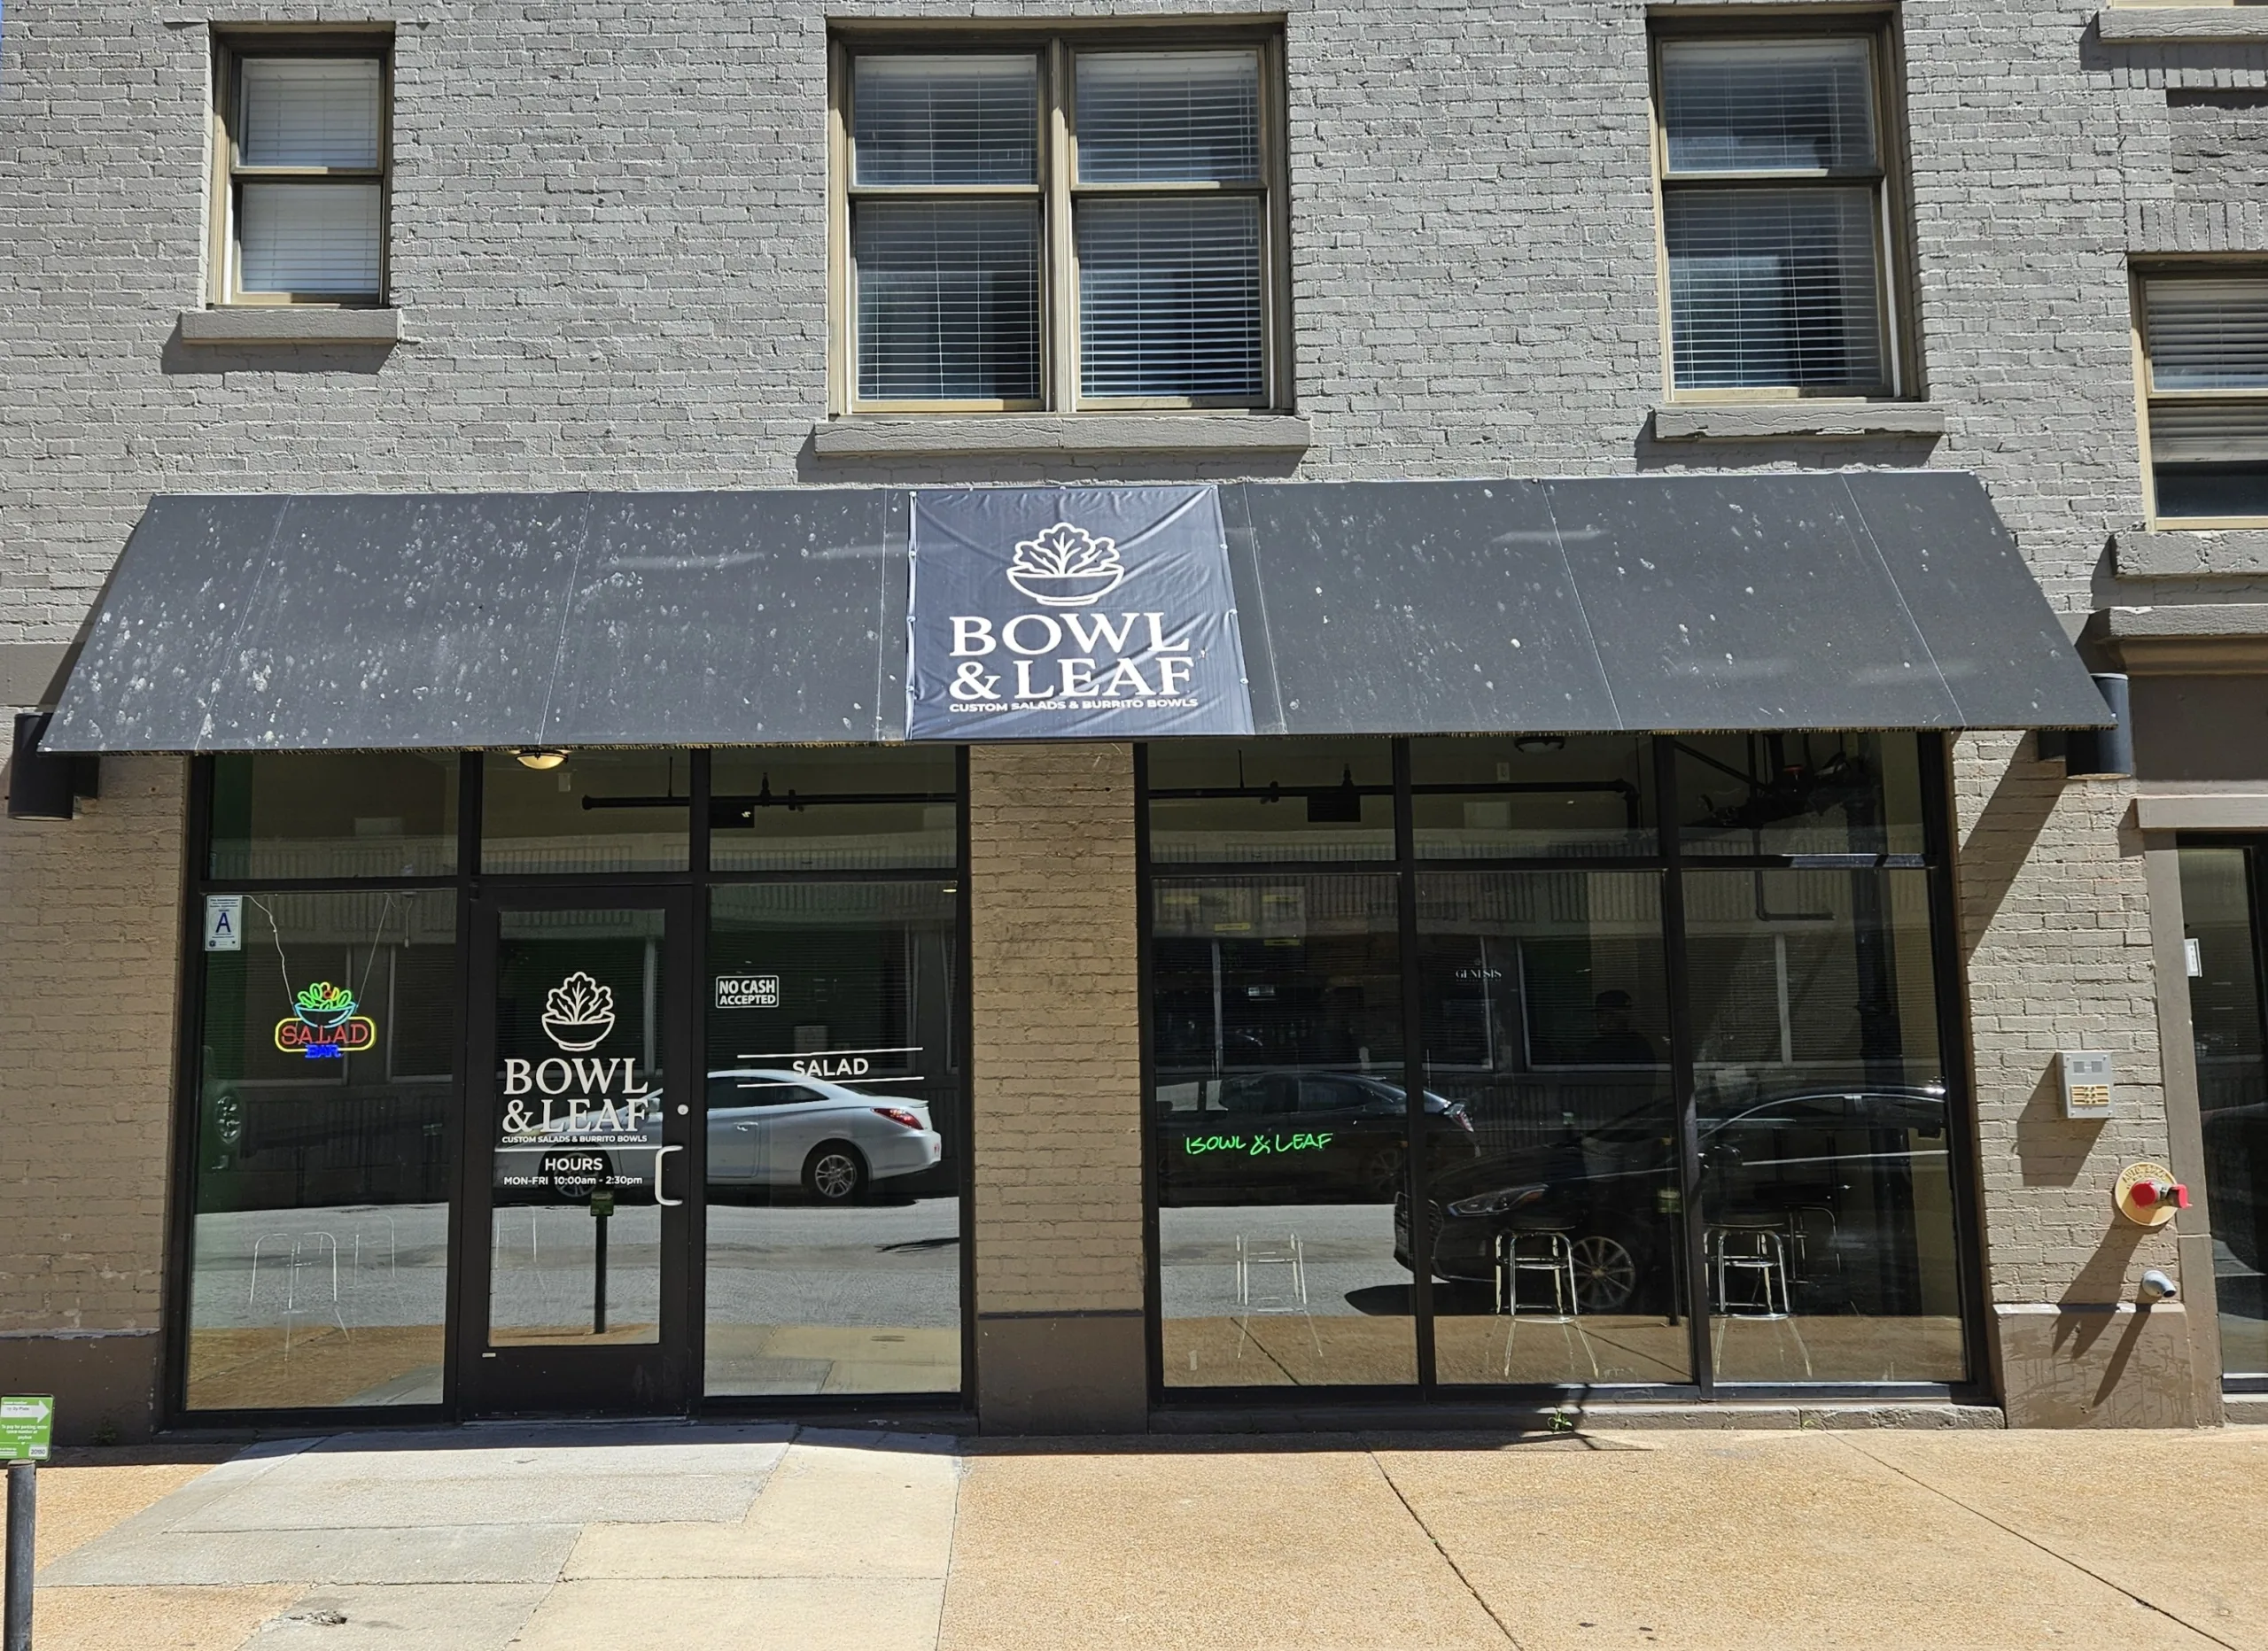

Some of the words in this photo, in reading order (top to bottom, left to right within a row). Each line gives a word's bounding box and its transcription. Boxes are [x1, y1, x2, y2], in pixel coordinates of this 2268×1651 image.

[949, 612, 1189, 656] BOWL
[949, 661, 1001, 701] &
[1014, 656, 1194, 699] LEAF
[949, 702, 1008, 713] CUSTOM
[1011, 701, 1067, 711] SALADS
[1068, 701, 1079, 710] &
[1082, 700, 1144, 709] BURRITO
[1147, 698, 1199, 709] BOWLS
[215, 912, 231, 933] A
[719, 981, 739, 994] NO
[741, 980, 775, 994] CASH
[719, 994, 776, 1005] ACCEPTED
[281, 1024, 369, 1045] SALAD
[305, 1044, 342, 1058] BAR
[503, 1058, 649, 1094] BOWL
[793, 1058, 869, 1076] SALAD
[502, 1099, 533, 1133] &
[540, 1098, 649, 1132] LEAF
[1185, 1136, 1247, 1154] BOWL
[1276, 1133, 1333, 1152] LEAF
[545, 1158, 603, 1171] HOURS
[504, 1176, 548, 1185] MON-FRI
[554, 1176, 596, 1185] 10:00am
[605, 1175, 643, 1186] 2:30pm
